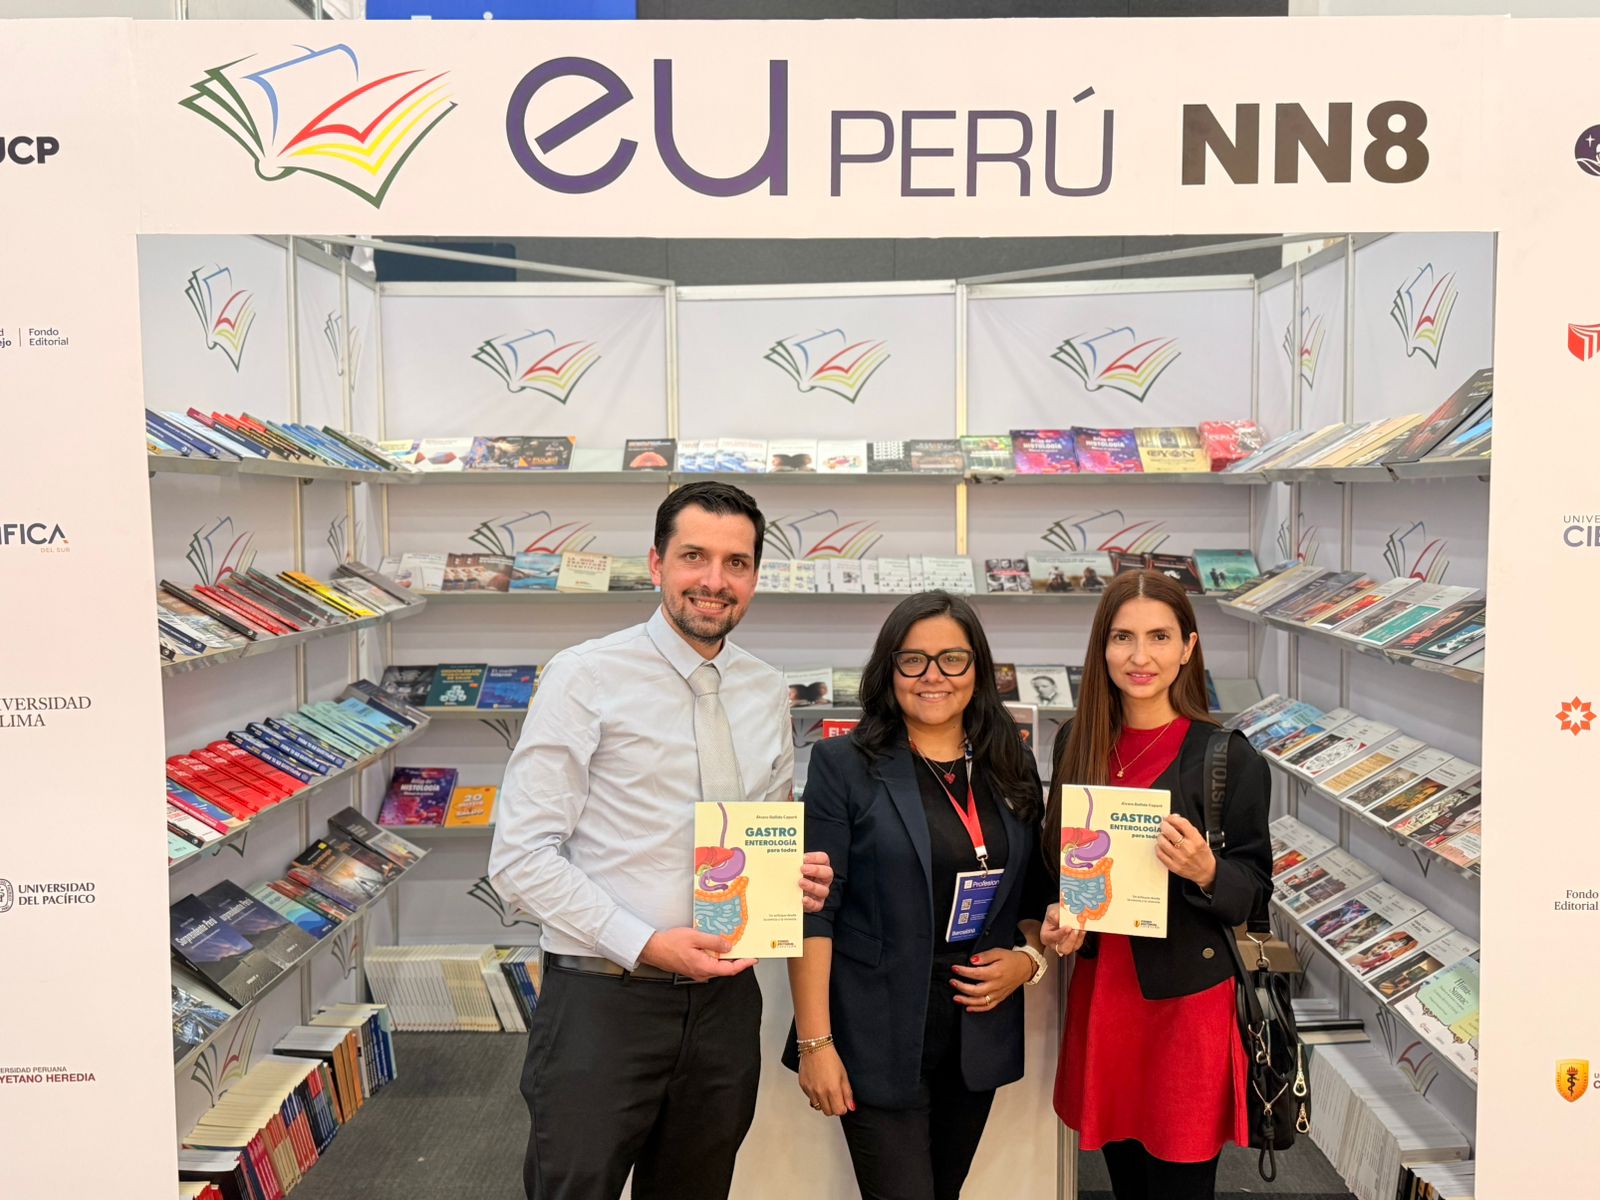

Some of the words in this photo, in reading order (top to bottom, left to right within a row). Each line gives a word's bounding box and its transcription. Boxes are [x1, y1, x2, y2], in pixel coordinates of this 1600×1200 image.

[506, 56, 788, 198] eu
[830, 86, 1114, 197] PERÚ
[1181, 100, 1430, 185] NN8
[0, 135, 60, 165] CP
[28, 328, 60, 337] Fondo
[29, 337, 69, 346] Editorial
[0, 713, 46, 728] LIMA
[400, 783, 440, 791] HISTOLOGÍA
[1110, 812, 1162, 824] GASTRO
[745, 826, 797, 837] GASTRO
[1110, 823, 1161, 833] ENTEROLOGÍA
[744, 838, 797, 847] ENTEROLOGÍA
[18, 882, 95, 894] UNIVERSIDAD
[18, 896, 39, 905] DEL
[42, 893, 96, 905] PACÍFICO
[1566, 889, 1599, 899] Fondo
[1554, 900, 1599, 911] Editorial
[46, 1073, 96, 1083] HEREDIA
